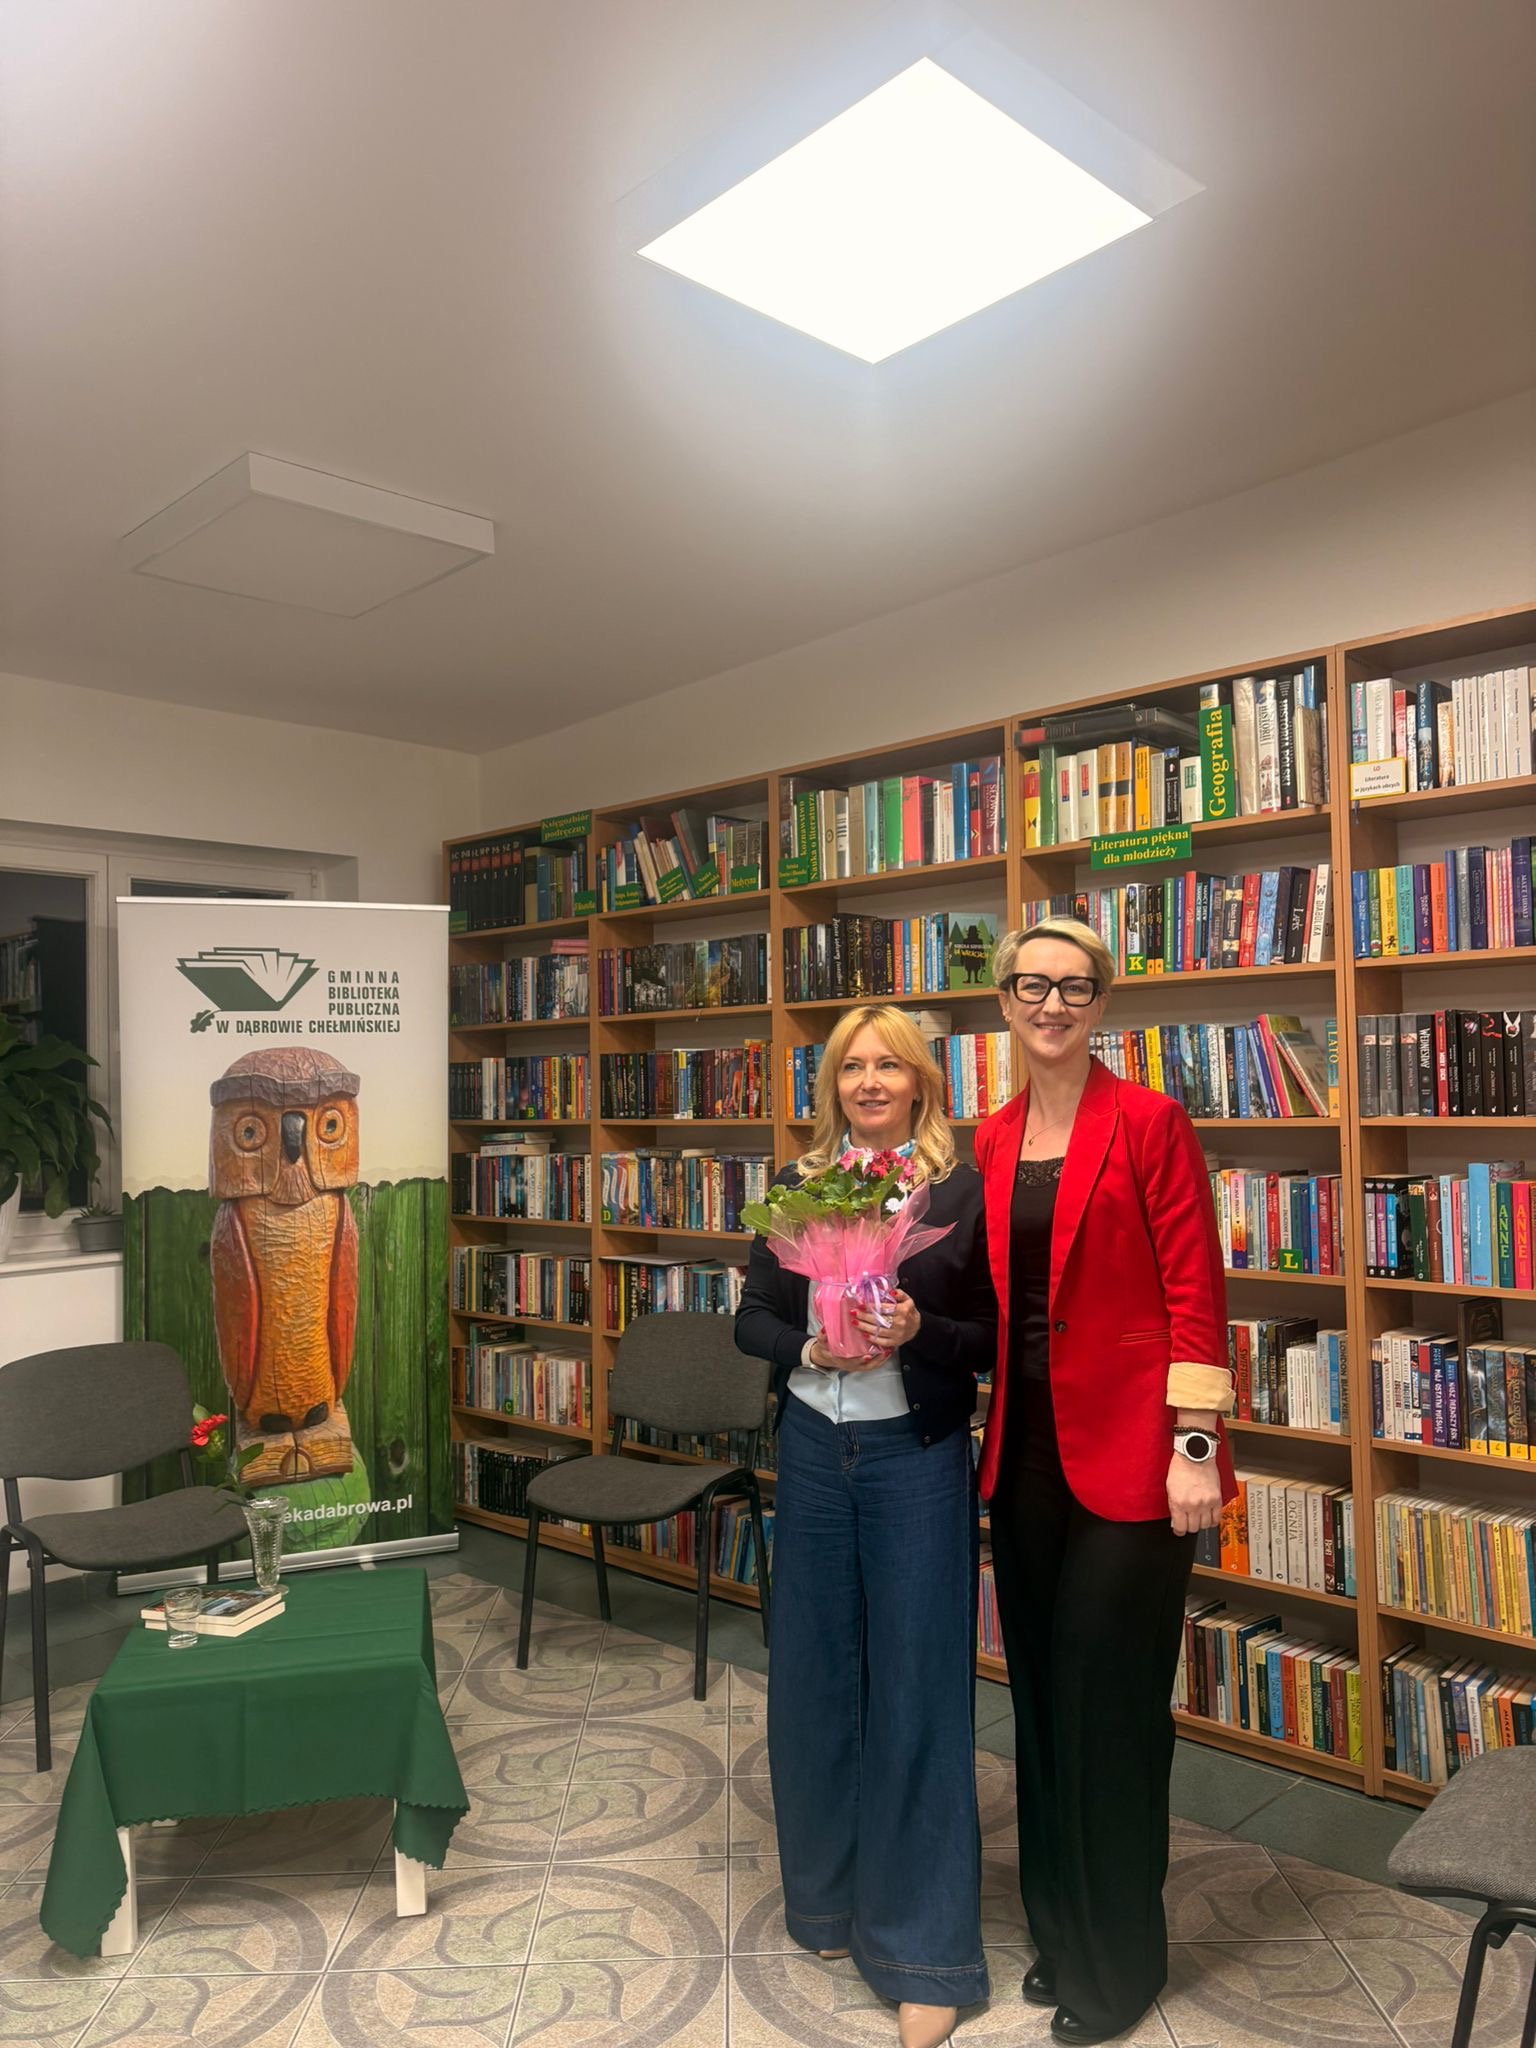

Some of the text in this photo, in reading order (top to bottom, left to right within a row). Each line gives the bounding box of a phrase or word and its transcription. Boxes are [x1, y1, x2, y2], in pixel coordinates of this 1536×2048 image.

[1206, 709, 1229, 816] Geografia
[542, 814, 589, 829] Księgozbiór
[799, 801, 807, 856] koznawstwo
[808, 792, 817, 840] literaturze
[544, 825, 586, 841] podręczny
[1093, 830, 1188, 851] Literatura piękna
[809, 851, 818, 880] Nauka
[1104, 846, 1177, 864] dla młodzieży
[1312, 900, 1324, 936] DIABOLIKA
[1129, 956, 1144, 971] K
[328, 970, 400, 984] GMINNA
[328, 987, 400, 1000] BIBLIOTEKA
[328, 1003, 400, 1016] PUBLICZNA
[216, 1017, 401, 1036] W DĄBROWIE CHEŁMIŃSKIEJ
[1328, 1031, 1339, 1063] LATO
[1420, 1028, 1431, 1068] WEDNESDAY
[527, 1106, 535, 1118] B
[603, 1212, 611, 1222] D
[1499, 1205, 1509, 1258] ANNE
[1517, 1205, 1527, 1258] ANNE
[1283, 1253, 1298, 1269] L
[1339, 1340, 1348, 1376] LONDON
[1435, 1369, 1443, 1382] MÓJ
[505, 1402, 512, 1412] C
[1435, 1383, 1443, 1408] OSTATNI
[283, 1494, 413, 1523] ekadabrowa.pl
[1256, 1490, 1264, 1534] KRÓLESTWO
[1277, 1496, 1285, 1536] KRÓLESTWO
[1288, 1500, 1297, 1541] OGNIA
